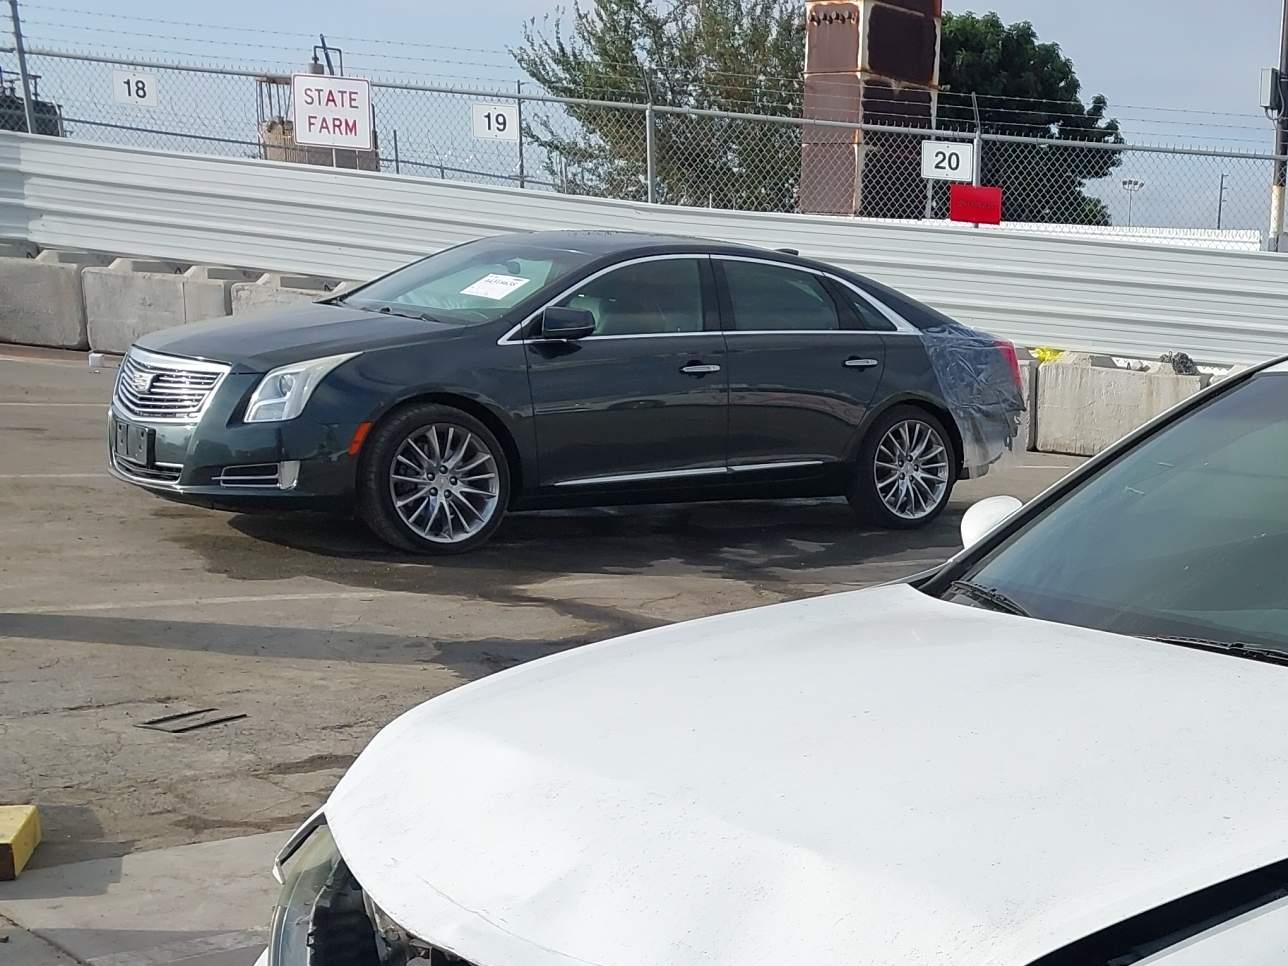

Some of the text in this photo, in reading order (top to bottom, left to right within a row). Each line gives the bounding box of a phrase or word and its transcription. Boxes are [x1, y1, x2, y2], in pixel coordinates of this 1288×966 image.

[123, 78, 147, 99] 18
[304, 87, 359, 109] STATE
[308, 115, 357, 136] FARM
[483, 112, 507, 132] 19
[934, 150, 960, 171] 20
